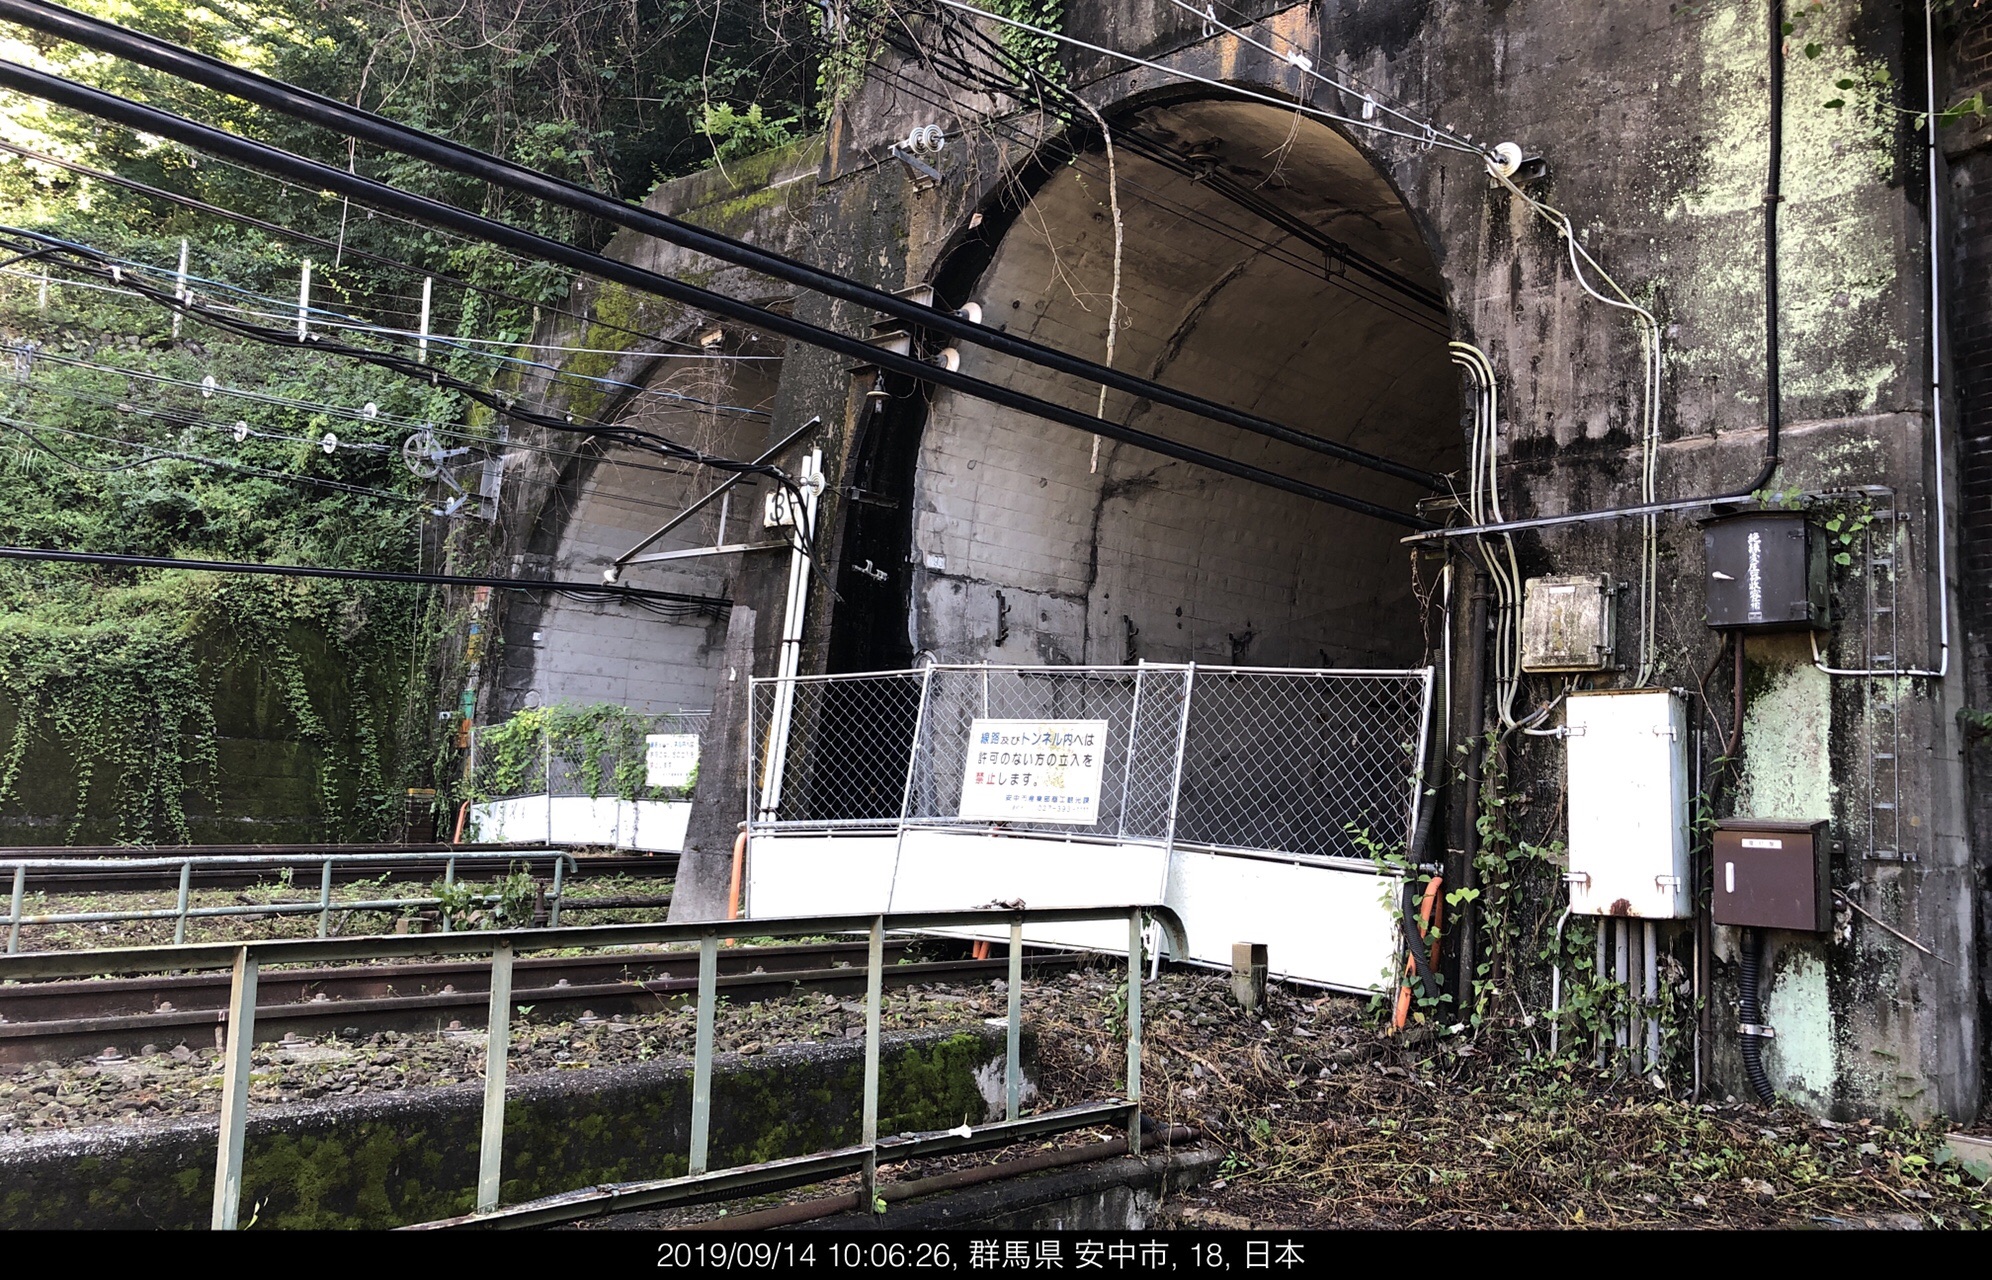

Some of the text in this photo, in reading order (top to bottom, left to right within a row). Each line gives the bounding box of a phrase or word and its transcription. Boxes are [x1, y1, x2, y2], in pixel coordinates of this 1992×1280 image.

[980, 731, 1095, 746] 線路及びトンネル内へは
[978, 751, 1093, 767] 許可のない方の立入を
[975, 772, 1038, 787] 禁止します。
